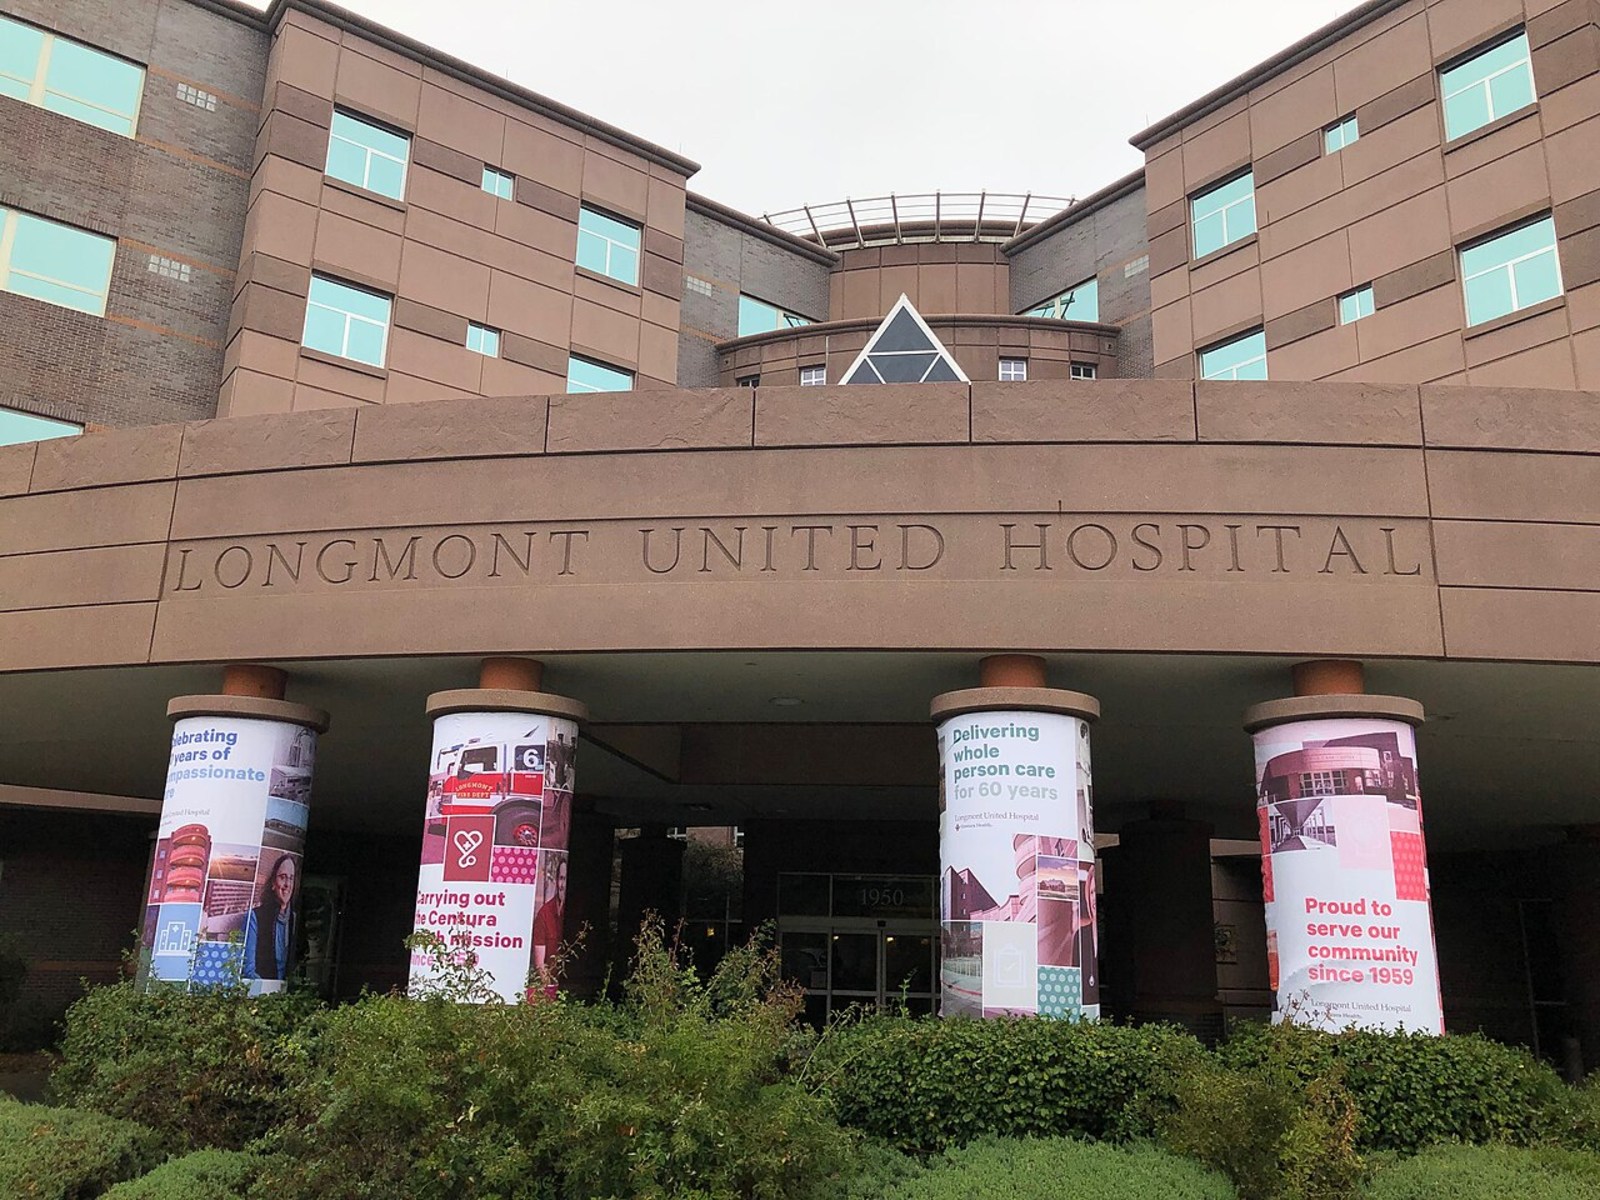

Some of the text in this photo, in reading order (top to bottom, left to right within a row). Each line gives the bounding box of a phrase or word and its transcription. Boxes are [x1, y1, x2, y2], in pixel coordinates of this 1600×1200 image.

[173, 522, 1422, 593] LONGMONT UNITED HOSPITAL
[953, 723, 1040, 744] Delivering
[173, 749, 207, 767] years
[212, 747, 231, 760] of
[523, 749, 539, 768] 6
[953, 743, 1000, 763] whole
[954, 764, 1056, 784] person care
[455, 782, 493, 792] LONGMONT
[954, 782, 1058, 800] for 60 years
[954, 811, 1040, 822] Longmont United Hospital
[474, 891, 506, 906] out
[859, 888, 904, 906] 1950
[1305, 898, 1392, 916] Proud to
[428, 910, 498, 927] Centura
[1307, 923, 1400, 939] serve our
[1308, 945, 1418, 966] community
[1308, 963, 1414, 986] since 1959
[1351, 1002, 1379, 1012] United
[1381, 1003, 1412, 1014] Hospital
